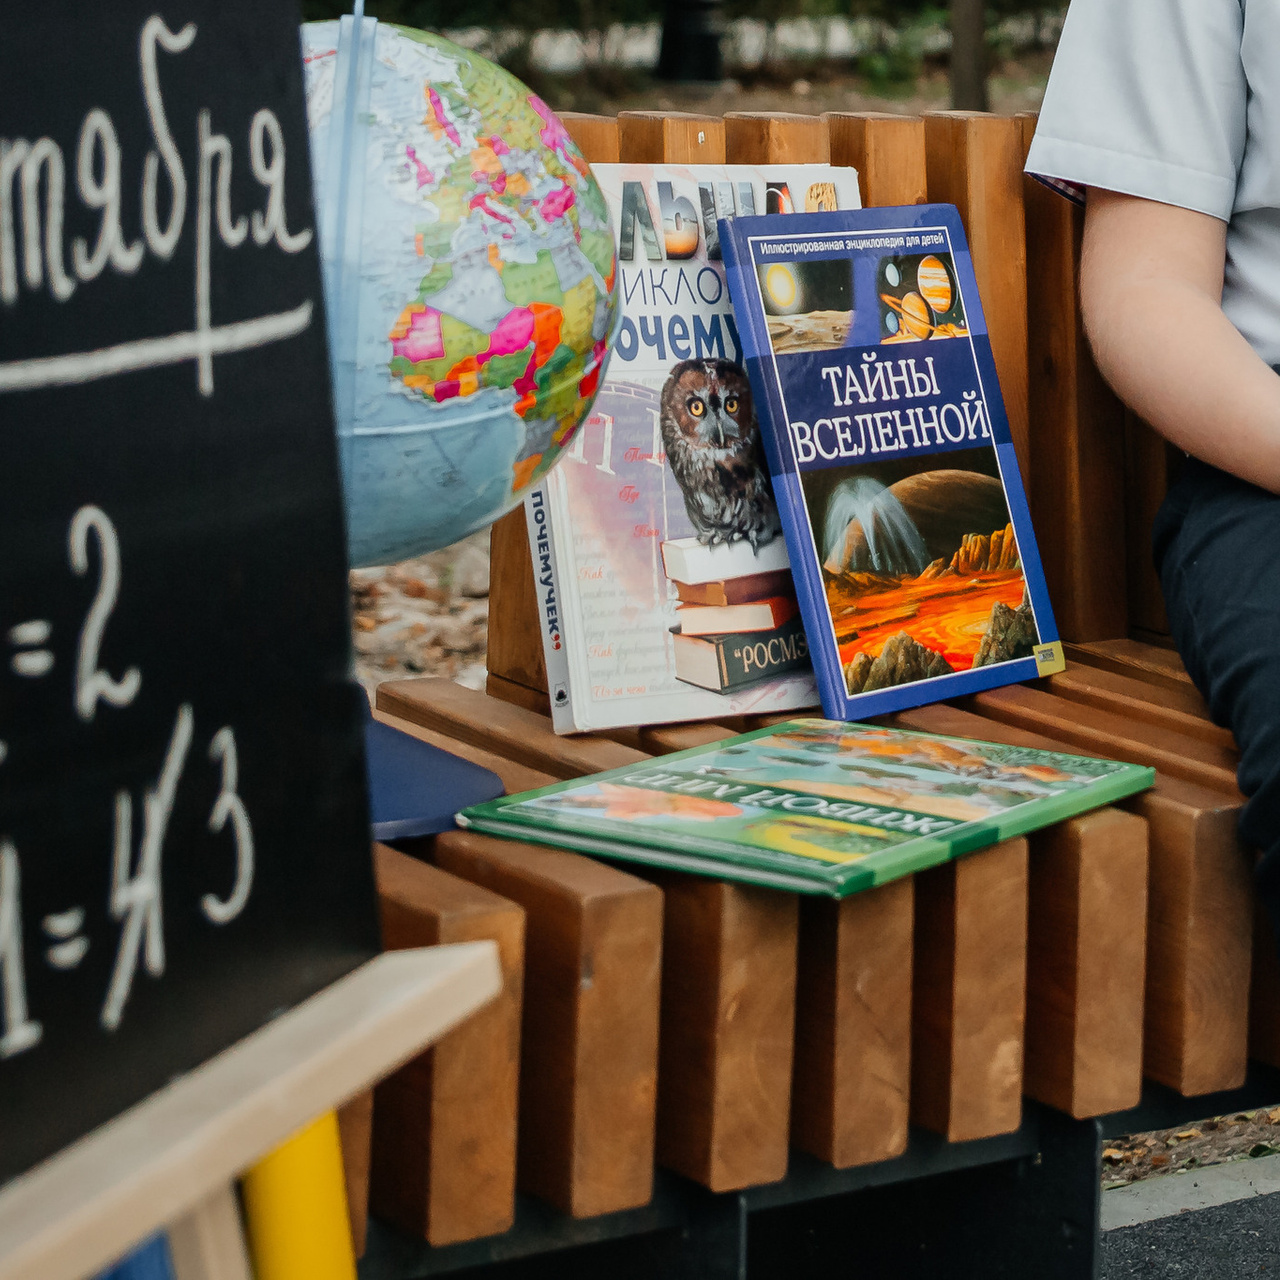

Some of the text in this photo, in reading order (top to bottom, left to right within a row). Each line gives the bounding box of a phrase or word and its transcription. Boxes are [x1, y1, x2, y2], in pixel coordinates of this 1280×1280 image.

[760, 232, 944, 256] Иллюстрированная энциклопедия для детей
[821, 351, 941, 407] ТАЙНЫ
[791, 390, 990, 463] ВСЕЛЕННОЙ
[624, 773, 955, 835] ЖИВОЙ МИР
